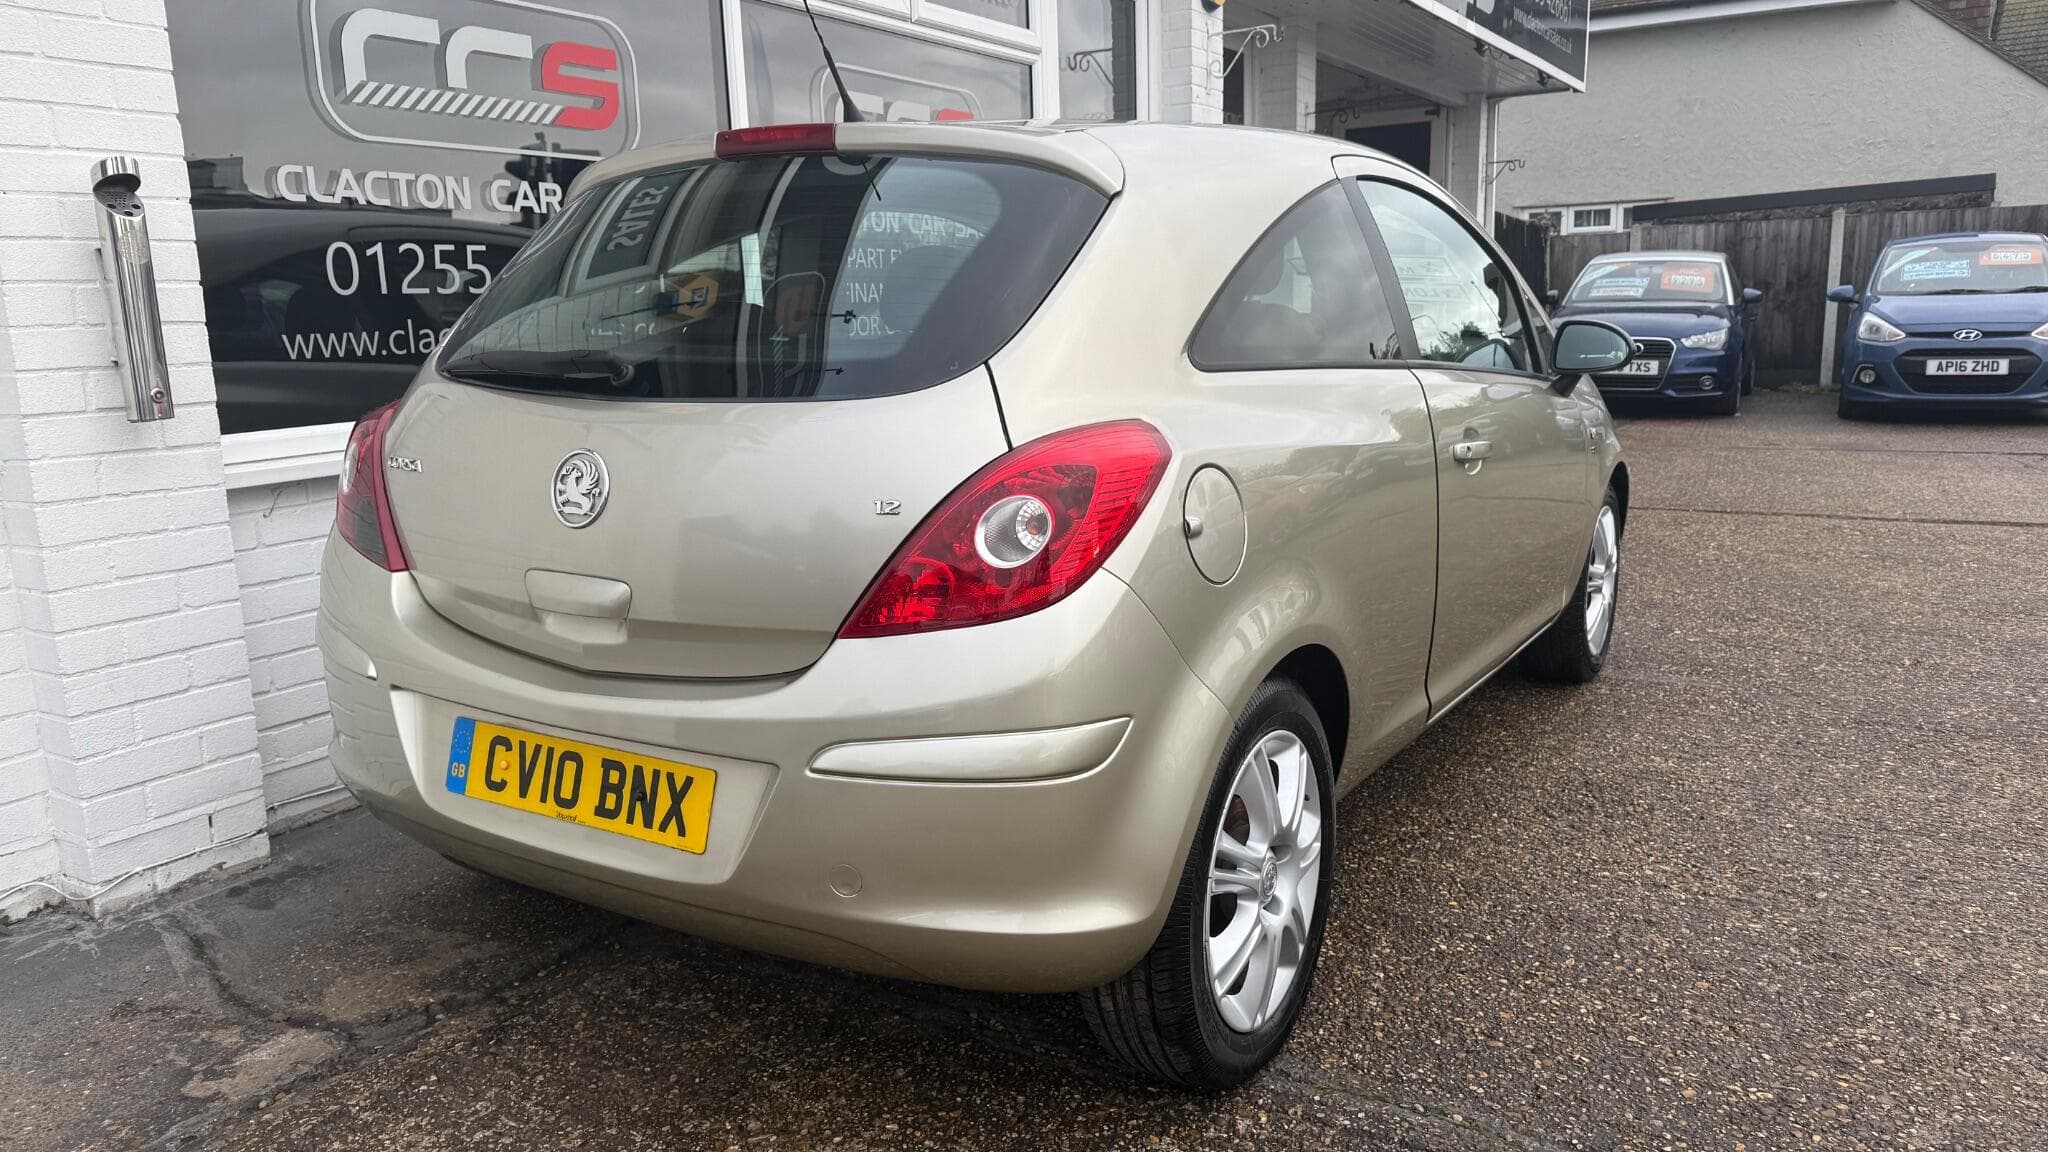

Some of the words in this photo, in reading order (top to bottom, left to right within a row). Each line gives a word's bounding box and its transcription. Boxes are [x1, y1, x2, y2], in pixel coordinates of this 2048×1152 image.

[276, 164, 473, 210] CLACTON
[490, 179, 563, 214] CAR
[847, 248, 885, 268] PART
[325, 241, 492, 296] 01255
[1629, 361, 1651, 373] TXS
[1936, 361, 1968, 373] AP16
[1971, 360, 2000, 373] ZHD
[451, 762, 465, 778] GB
[484, 734, 584, 810] CV10
[594, 757, 694, 838] BNX
